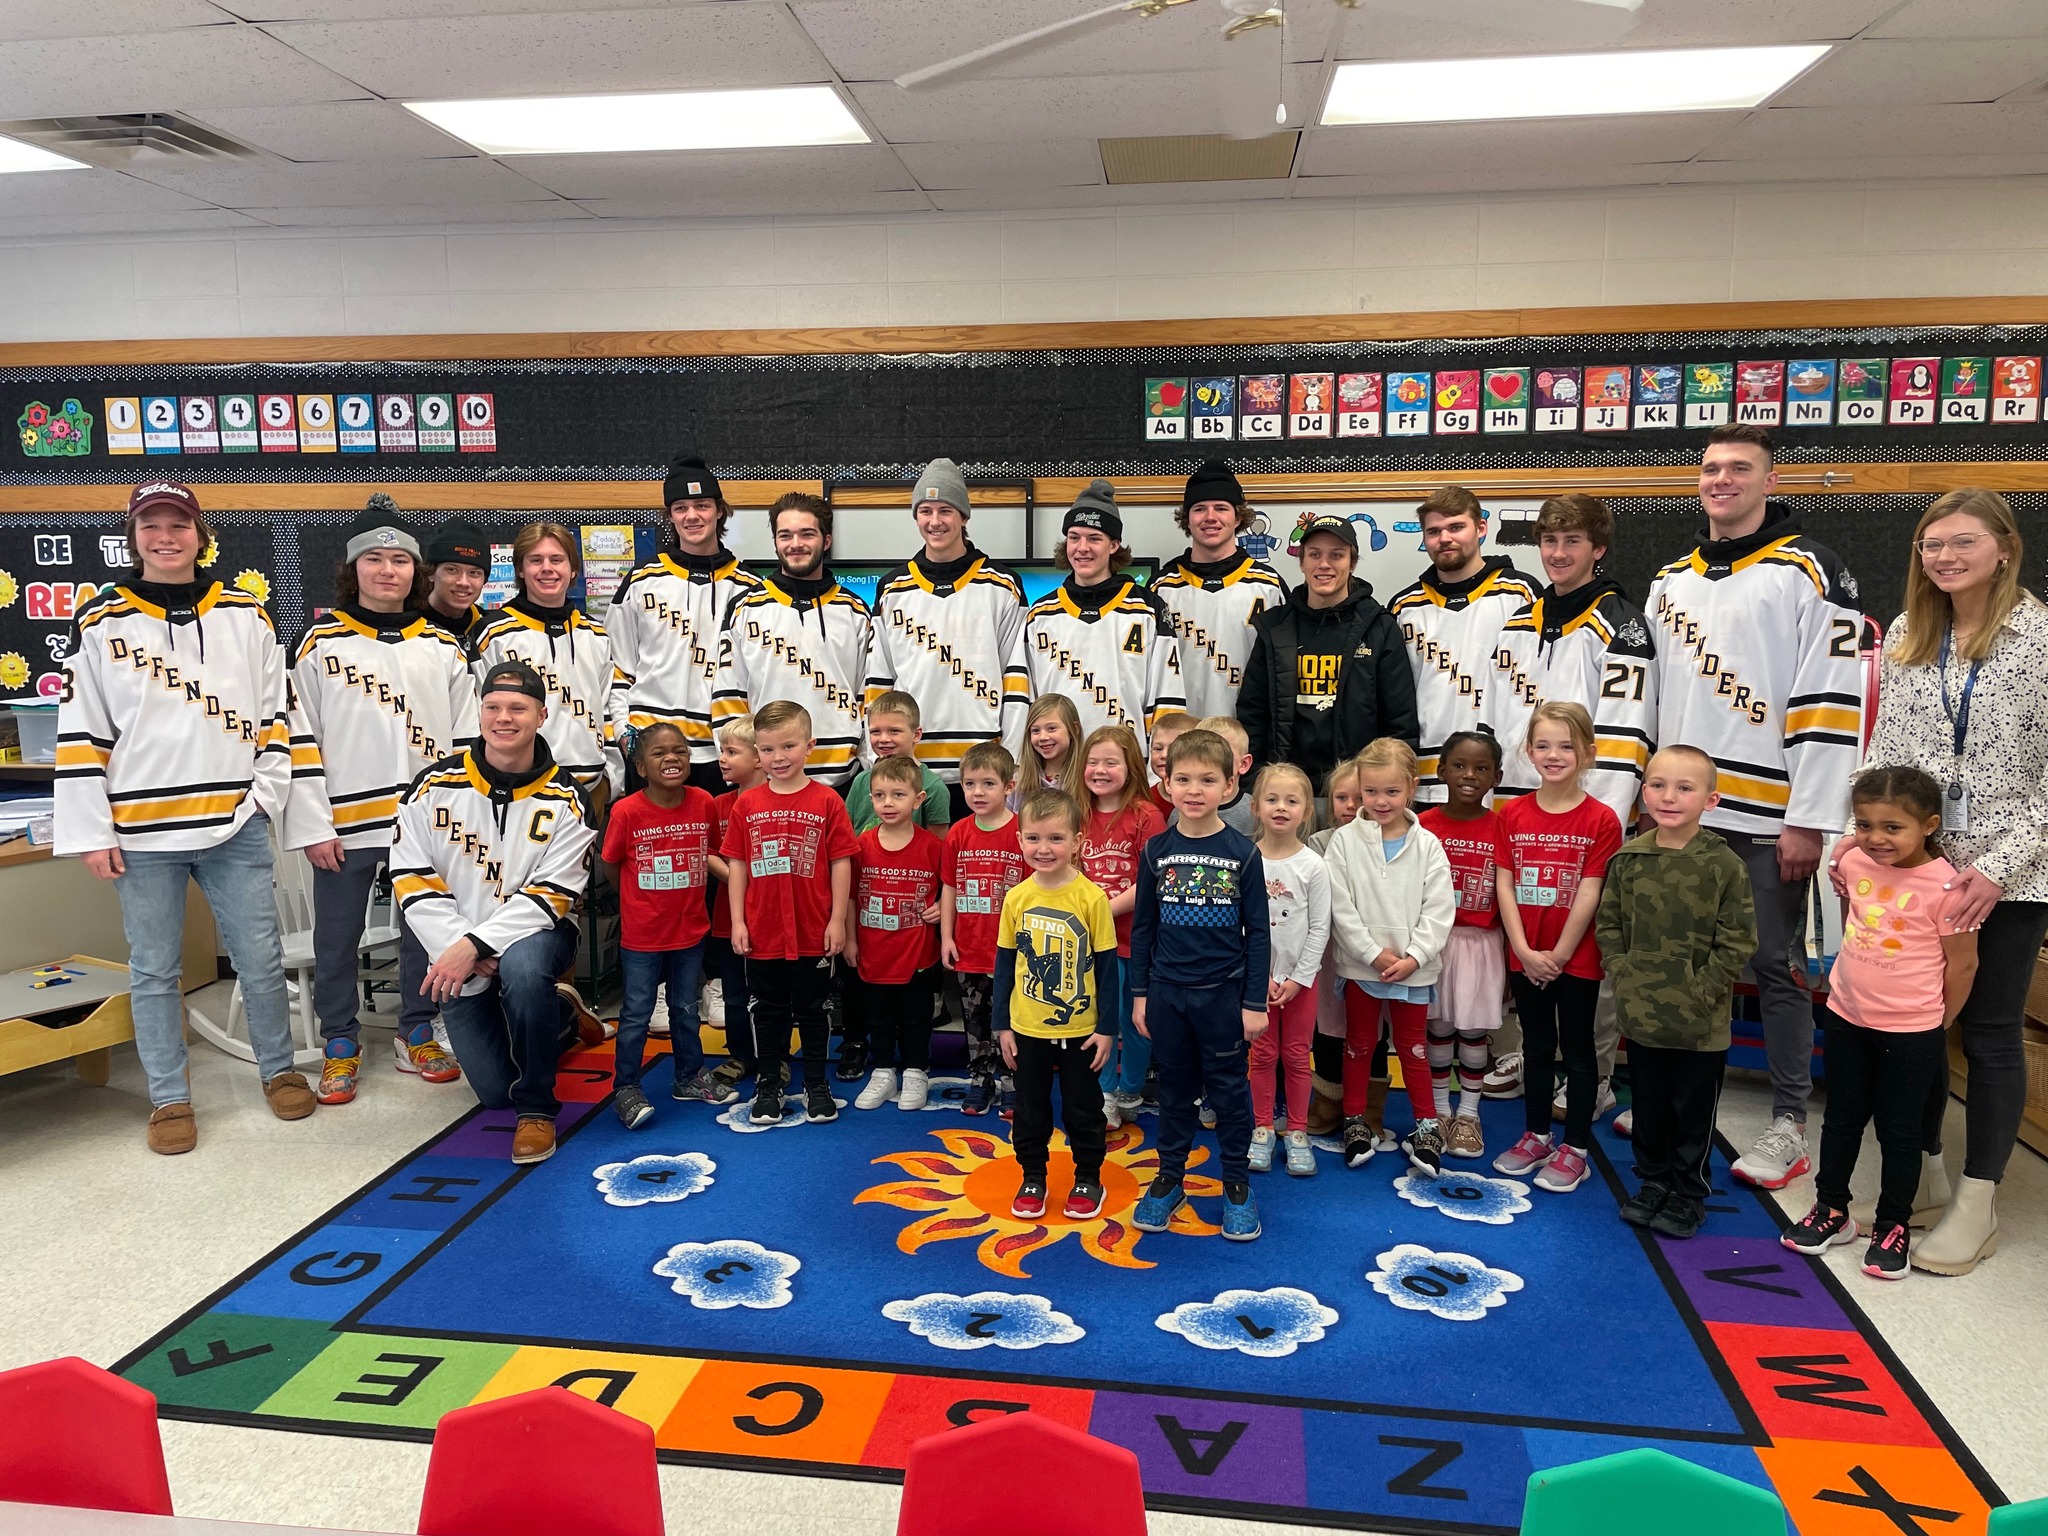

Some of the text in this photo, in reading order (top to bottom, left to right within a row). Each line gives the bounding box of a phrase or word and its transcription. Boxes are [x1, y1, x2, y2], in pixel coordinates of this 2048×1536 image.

[120, 405, 126, 423] 1
[155, 405, 168, 422] 2
[191, 404, 205, 421] 3
[231, 403, 244, 420] 4
[271, 402, 283, 420] 5
[311, 403, 323, 420] 6
[349, 402, 361, 420] 7
[391, 402, 403, 420] 8
[429, 402, 441, 420] 9
[467, 402, 487, 420] 10
[1644, 406, 1668, 423] Kk
[1699, 404, 1715, 421] Ll
[1740, 404, 1776, 420] Mm
[1796, 403, 1822, 419] Nn
[1847, 402, 1875, 419] Oo
[1900, 401, 1924, 421] Pp
[1947, 401, 1979, 421] Qq
[2005, 399, 2025, 416] Rr
[1201, 418, 1224, 433] Bb
[1251, 417, 1273, 432] Cc
[1298, 415, 1323, 431] Dd
[1349, 414, 1370, 429] Ee
[1398, 413, 1417, 429] Ff
[1443, 411, 1469, 430] Gg
[1492, 411, 1518, 427] Hh
[1549, 409, 1564, 425] Ii
[1597, 408, 1614, 427] Jj
[1154, 419, 1177, 434] Aa
[34, 535, 72, 565] BE
[834, 575, 846, 584] Up
[846, 575, 866, 585] Song
[1123, 623, 1144, 653] A
[1830, 619, 1857, 657] 2
[719, 638, 732, 667] 2
[1171, 612, 1241, 685] EFENDE
[892, 609, 999, 707] DEFENDERS
[1167, 645, 1180, 675] 4
[1298, 654, 1343, 679] OR
[1657, 593, 1767, 724] DEFENDERS
[747, 621, 858, 719] DEFENDERS
[1299, 679, 1339, 695] OCK
[1602, 663, 1646, 701] 21
[107, 637, 258, 746] DEFENDER
[529, 809, 553, 842] C
[746, 811, 770, 823] LIVING
[797, 811, 826, 824] STORY
[633, 826, 662, 838] LIVING
[664, 822, 690, 833] GOD'S
[1538, 834, 1569, 843] GOD'S
[1445, 838, 1474, 848] GOD'S
[975, 849, 998, 857] GOD'S
[881, 867, 907, 875] GOD'S
[908, 869, 934, 878] STORY
[1467, 876, 1478, 884] Sw
[1162, 895, 1232, 905] Mario Luigi Yoshi
[1030, 918, 1065, 934] DINO
[1065, 940, 1074, 990] SQUAD
[636, 1169, 677, 1184] 4
[392, 1175, 481, 1203] H
[290, 1250, 382, 1286] G
[704, 1261, 754, 1284] 3
[1401, 1264, 1471, 1299] 10
[1702, 1264, 1803, 1299] V
[964, 1312, 1003, 1338] 2
[1235, 1314, 1276, 1340] 1
[166, 1339, 275, 1378] F
[333, 1352, 445, 1407] E
[1756, 1354, 1888, 1417] W
[732, 1381, 825, 1437] C
[1154, 1413, 1249, 1477] A
[1378, 1434, 1468, 1501] Z
[1811, 1465, 1965, 1536] X
